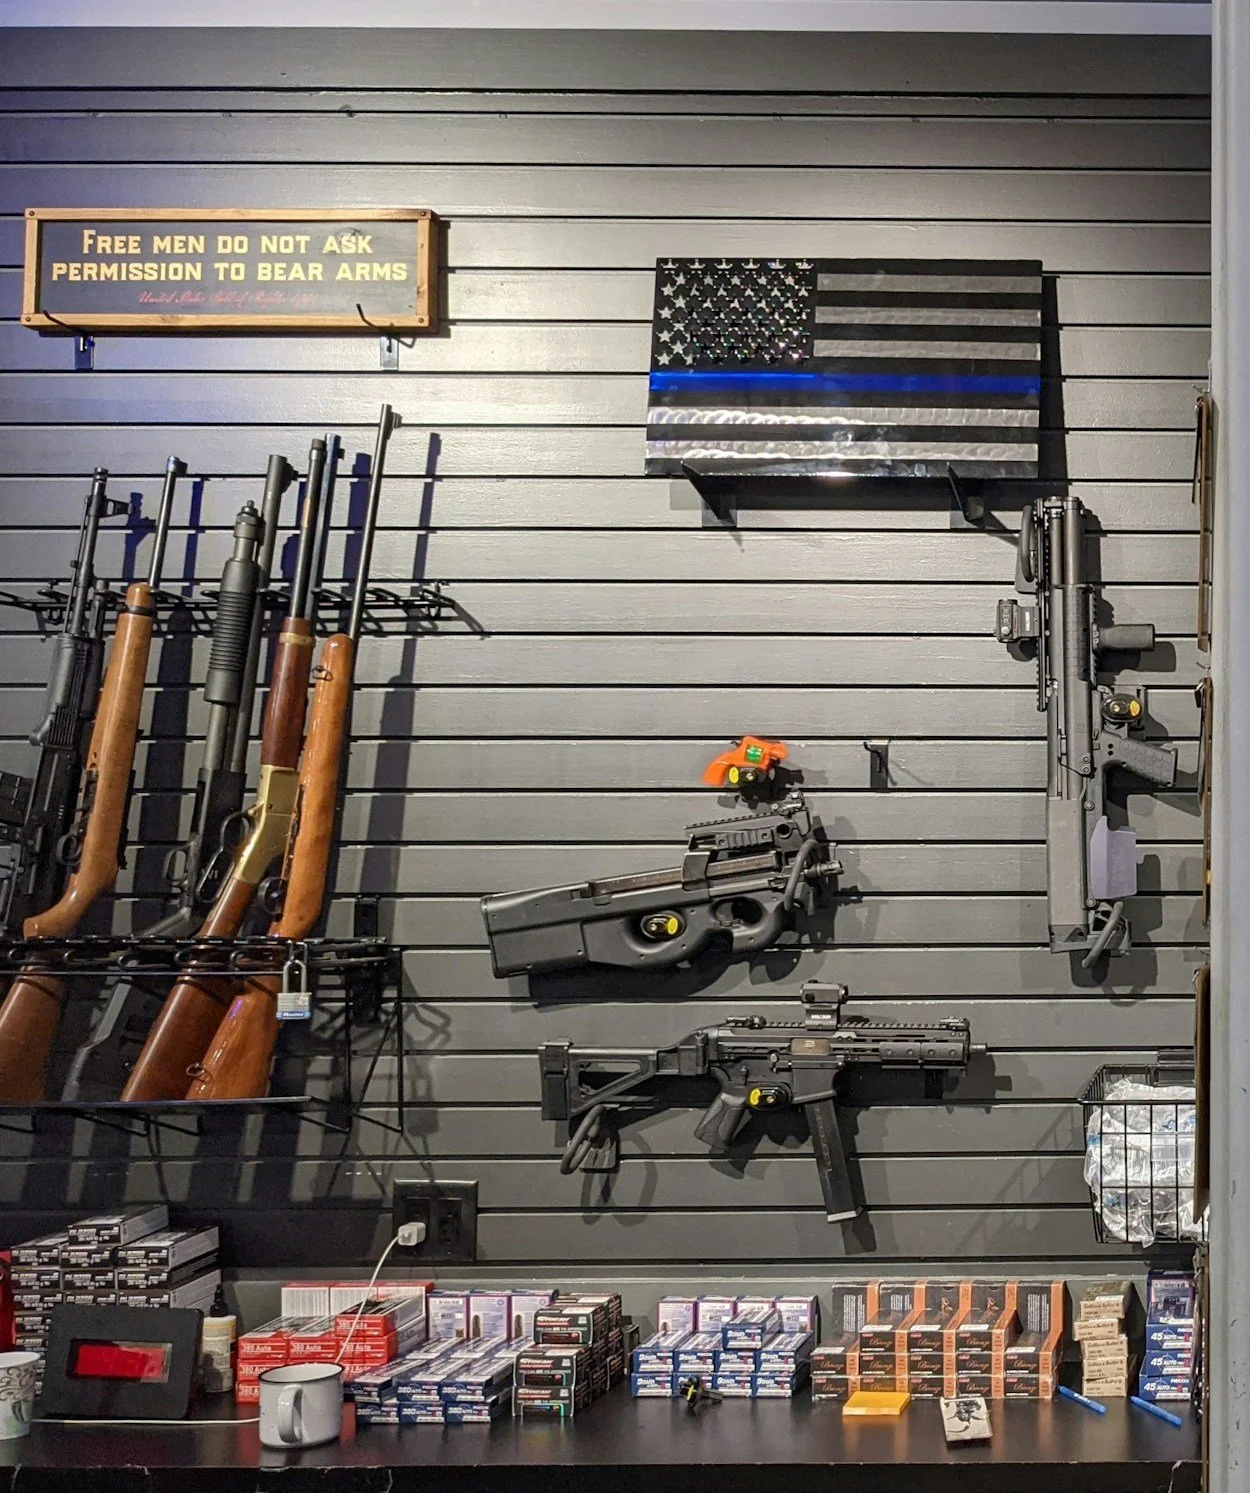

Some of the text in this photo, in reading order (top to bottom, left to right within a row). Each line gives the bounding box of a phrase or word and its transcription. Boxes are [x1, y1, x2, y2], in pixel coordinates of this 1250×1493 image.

[82, 229, 373, 254] FREE MEN DO NOT ASK
[51, 262, 408, 281] PERMISSION TO BEAR ARMS
[1151, 1358, 1163, 1366] 45
